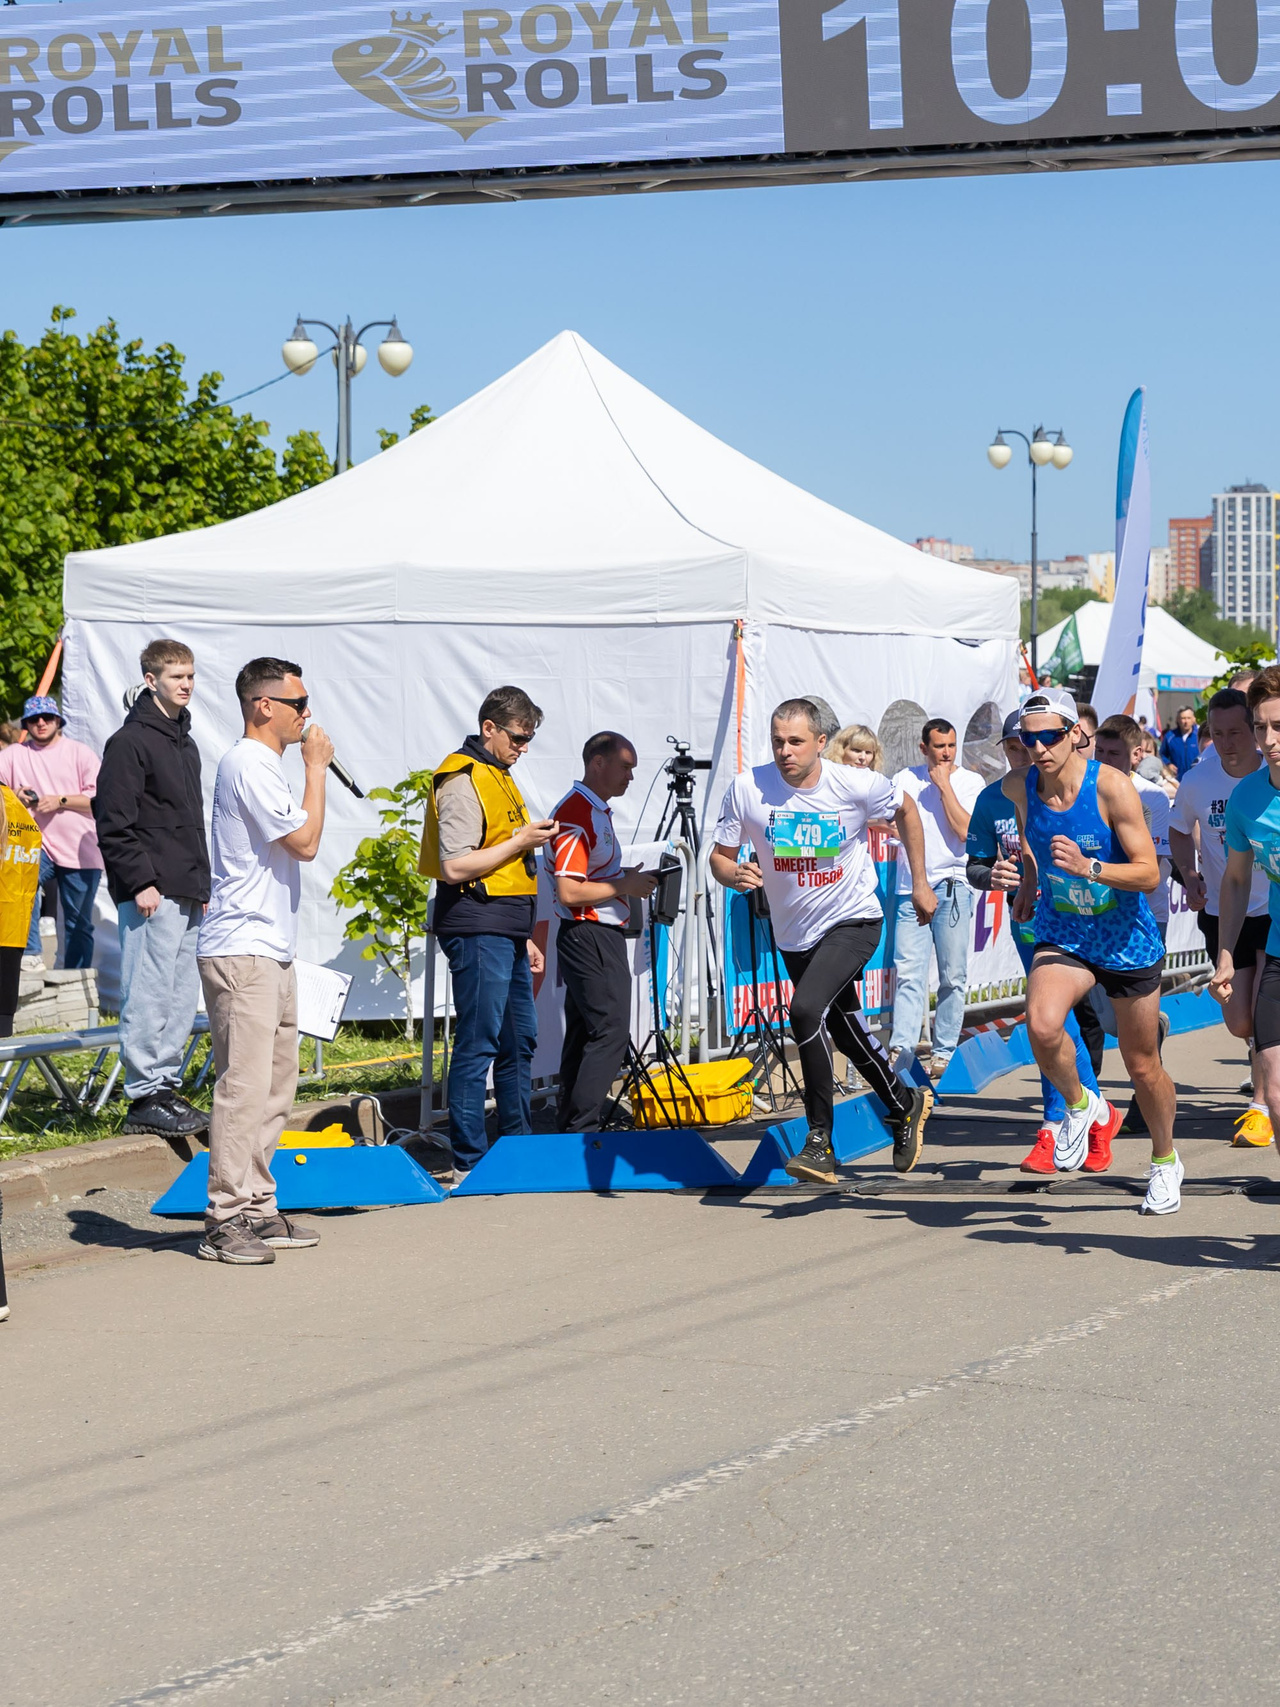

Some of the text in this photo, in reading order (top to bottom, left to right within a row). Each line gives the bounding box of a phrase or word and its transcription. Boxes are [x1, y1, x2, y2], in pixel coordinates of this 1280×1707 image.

[463, 0, 729, 58] ROYAL
[0, 25, 243, 84] ROYAL
[465, 49, 729, 114] ROLLS
[0, 78, 242, 137] ROLLS
[793, 823, 822, 846] 479
[774, 857, 818, 873] ВМЕСТЕ
[808, 865, 844, 888] ТОБОЙ
[1068, 888, 1095, 906] 474
